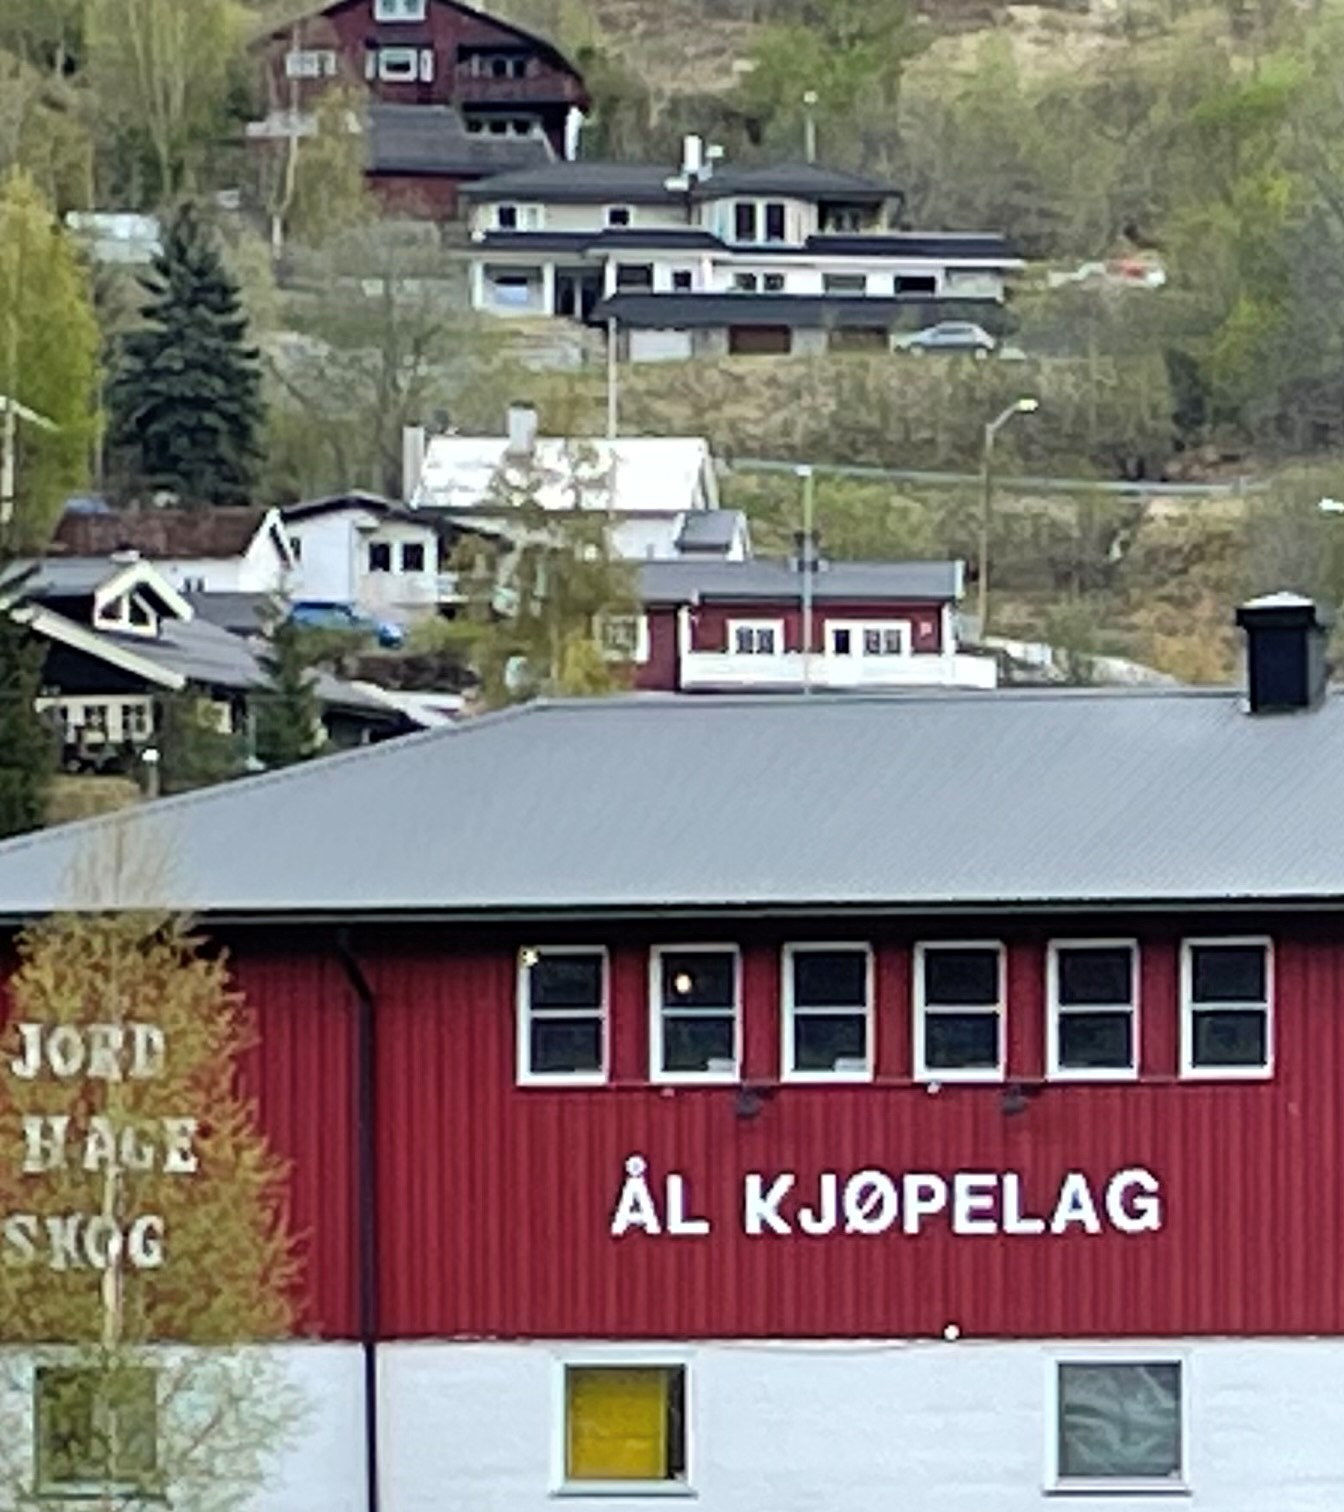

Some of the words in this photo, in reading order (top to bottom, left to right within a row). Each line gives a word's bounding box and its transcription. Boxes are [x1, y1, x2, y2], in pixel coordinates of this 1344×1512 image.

[10, 1023, 165, 1080] JORD
[22, 1115, 199, 1173] HAGE
[610, 1155, 710, 1234] ÅL
[744, 1169, 1161, 1234] KJØPELAG
